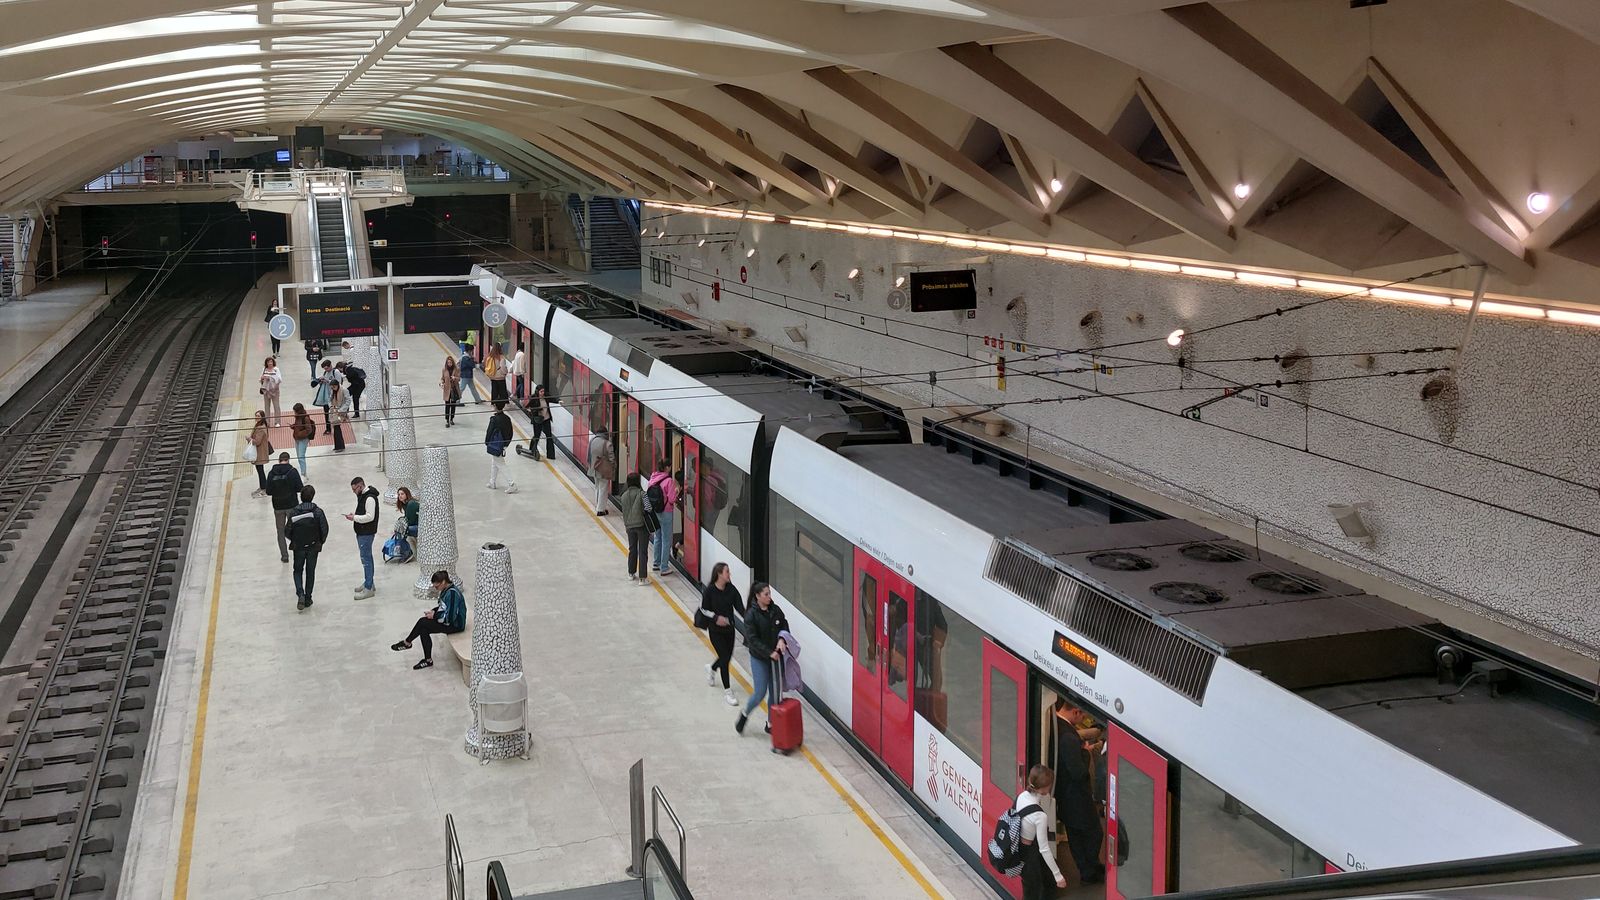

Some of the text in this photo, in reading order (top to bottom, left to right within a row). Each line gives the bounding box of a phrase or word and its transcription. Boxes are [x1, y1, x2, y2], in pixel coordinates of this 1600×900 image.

[491, 312, 500, 324] 3
[278, 323, 288, 336] 2
[1033, 649, 1055, 671] Deixeu
[1055, 664, 1069, 682] eixir
[1074, 676, 1094, 697] Dejen
[1094, 690, 1110, 706] salir
[1346, 852, 1369, 872] Dei
